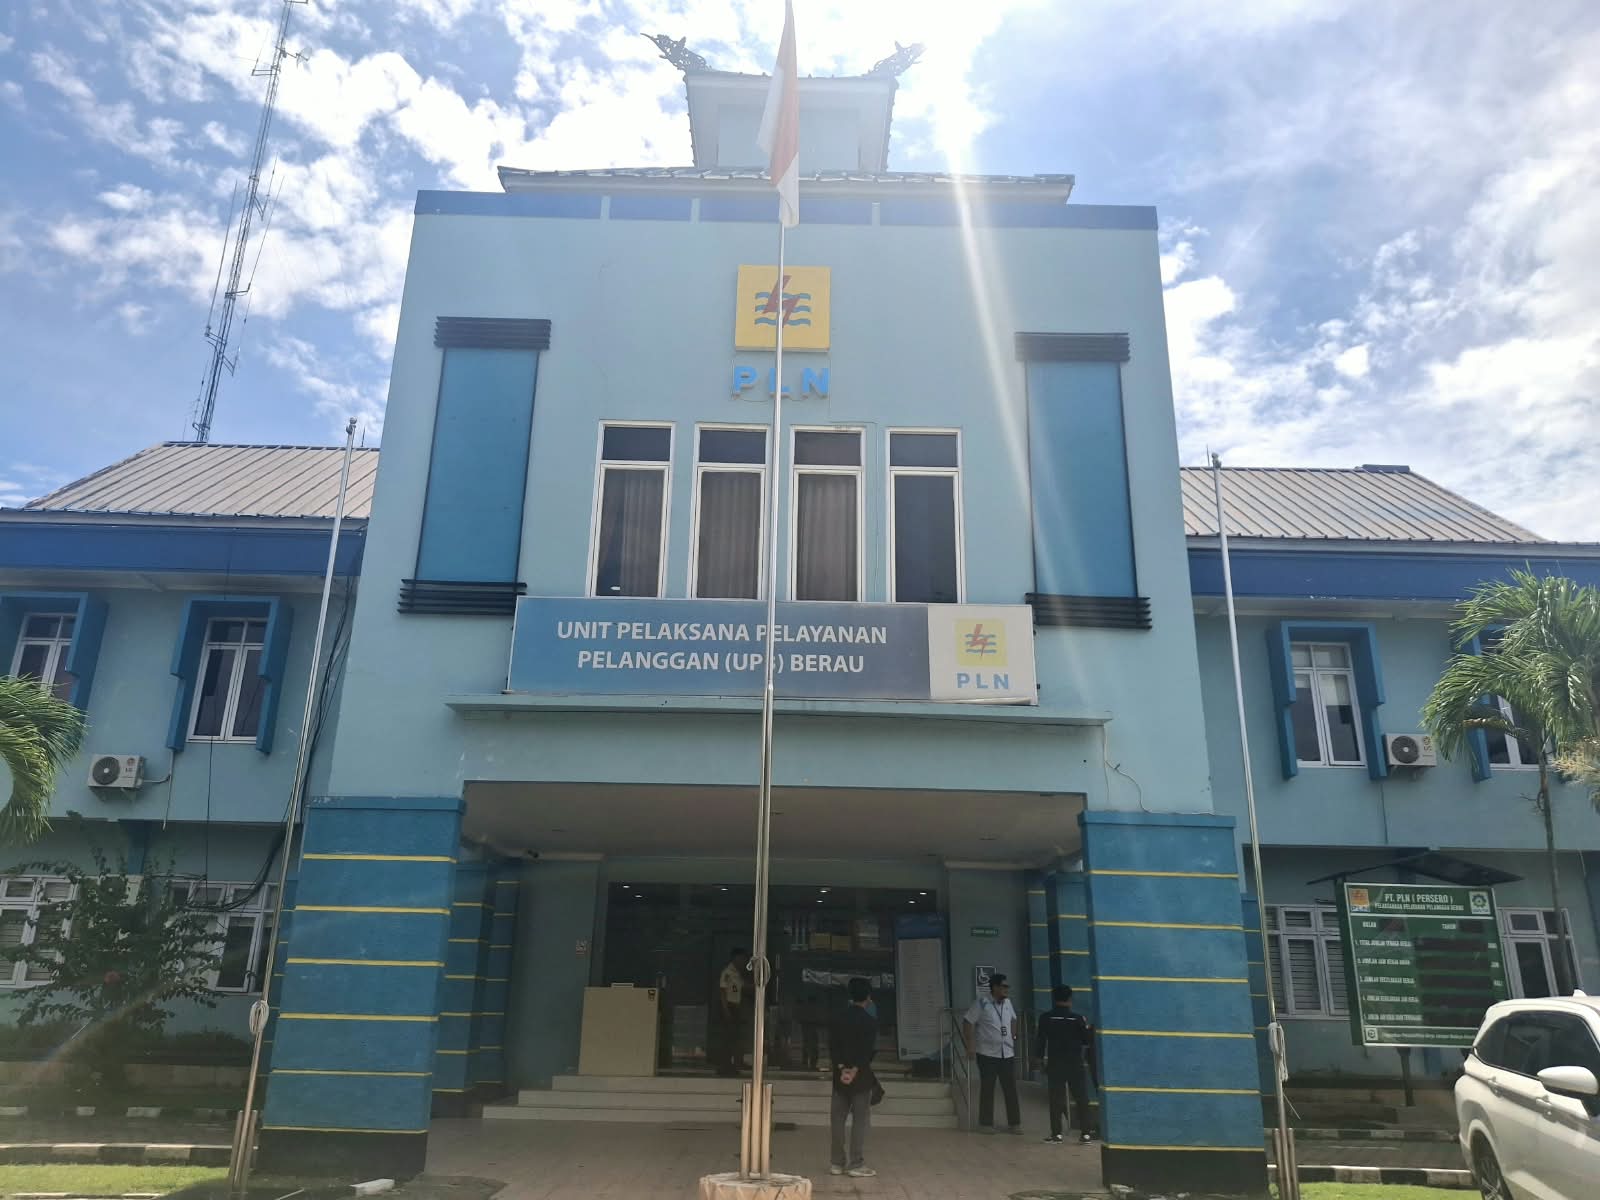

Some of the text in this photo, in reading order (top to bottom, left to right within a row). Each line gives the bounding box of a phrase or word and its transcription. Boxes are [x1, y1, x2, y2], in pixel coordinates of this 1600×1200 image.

[733, 366, 829, 396] PLN
[557, 621, 887, 644] UNIT PELAKSANA PELAYANAN
[577, 650, 865, 674] PELANGGAN (UP) BERAU
[957, 672, 1009, 690] PLN
[1396, 893, 1410, 903] PLN
[1416, 894, 1449, 904] PERSERO
